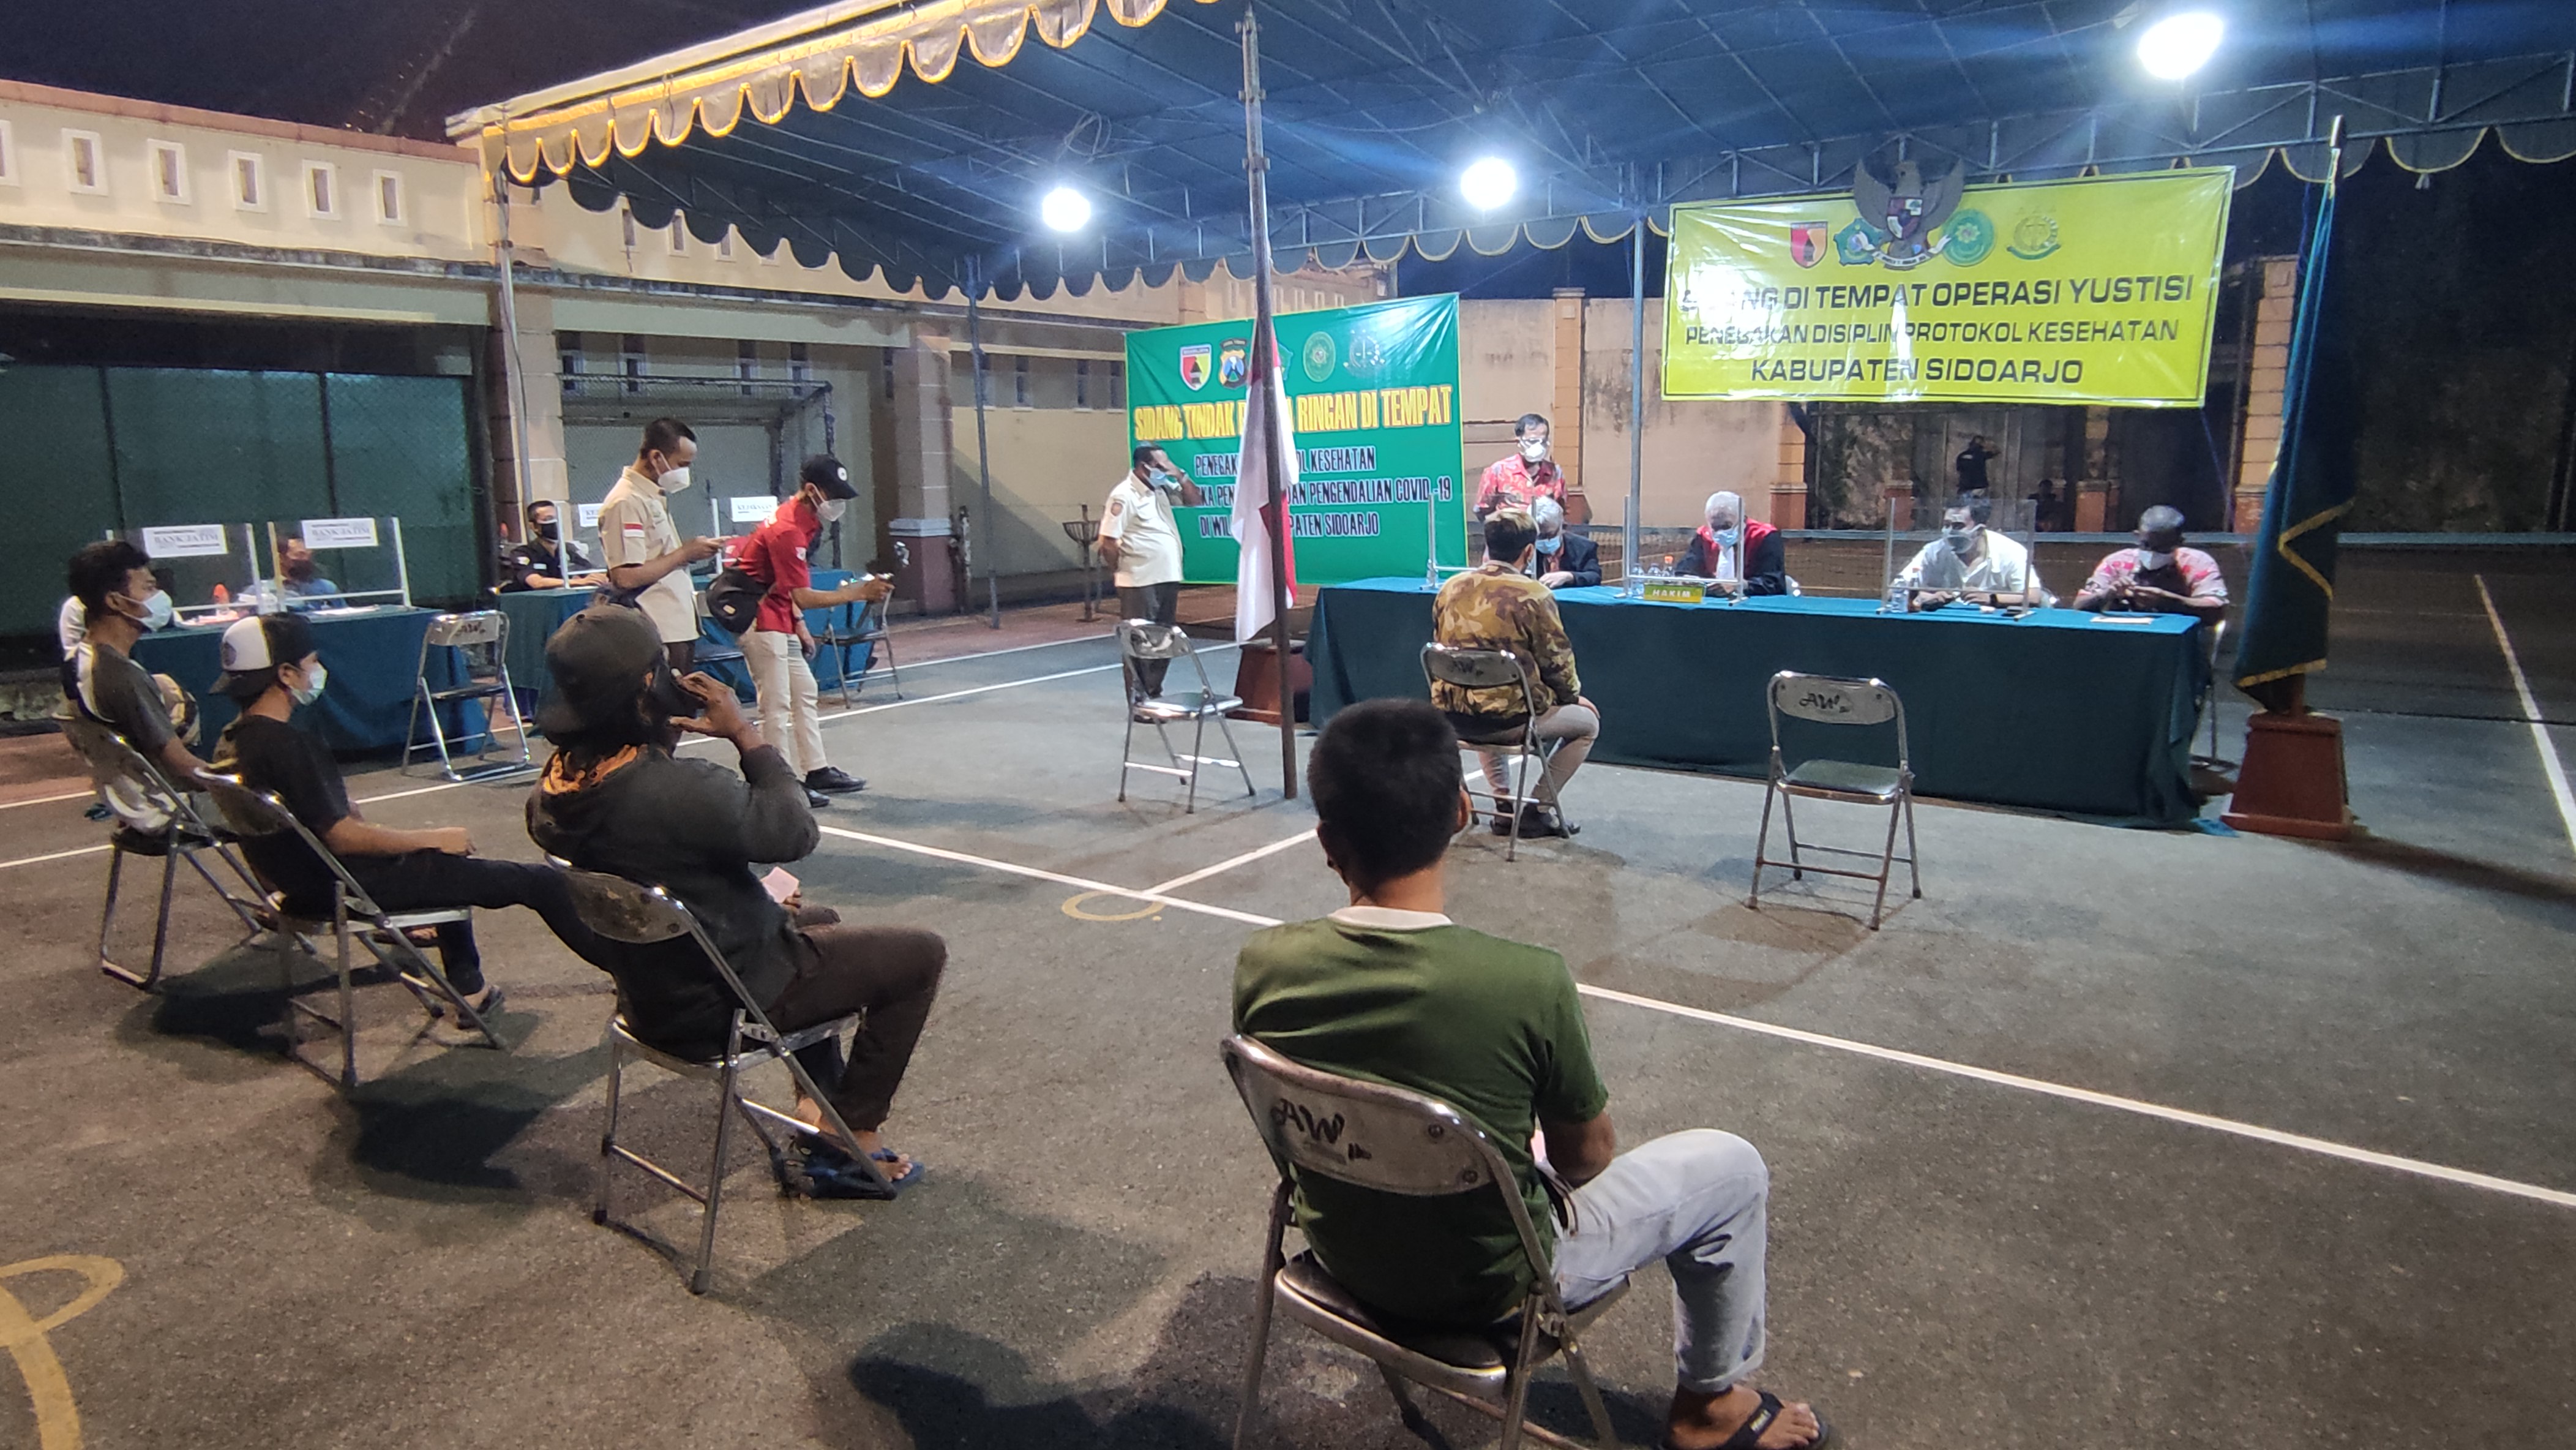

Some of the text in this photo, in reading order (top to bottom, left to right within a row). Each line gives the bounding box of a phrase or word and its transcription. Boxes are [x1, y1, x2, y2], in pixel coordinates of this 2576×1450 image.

[1784, 287, 1810, 309] DI
[1815, 283, 1928, 309] TEMPAT
[1933, 279, 2061, 307] OPERASI
[2069, 274, 2194, 304] YUSTISI
[1905, 321, 2023, 342] PROTOKOL
[2027, 319, 2179, 342] KESEHATAN
[1751, 358, 2083, 383] KABUPATEN SIDOARJO
[1134, 405, 1183, 440] SIDANG
[1183, 402, 1236, 439] TINDAK
[1297, 392, 1358, 432] RINGAN
[1360, 389, 1379, 429] DI
[1380, 385, 1452, 427] TEMPAT
[1196, 454, 1238, 476] PENEGAK
[1310, 447, 1375, 472] KESEHATAN
[1310, 478, 1392, 504] PENGENDALIAN
[1395, 478, 1429, 501] COVID
[1200, 516, 1210, 536] DI
[1325, 512, 1379, 535] SIDOARJO
[1653, 589, 1691, 598] HAKIM
[1799, 693, 1840, 709] AW
[1270, 1098, 1345, 1144] AW
